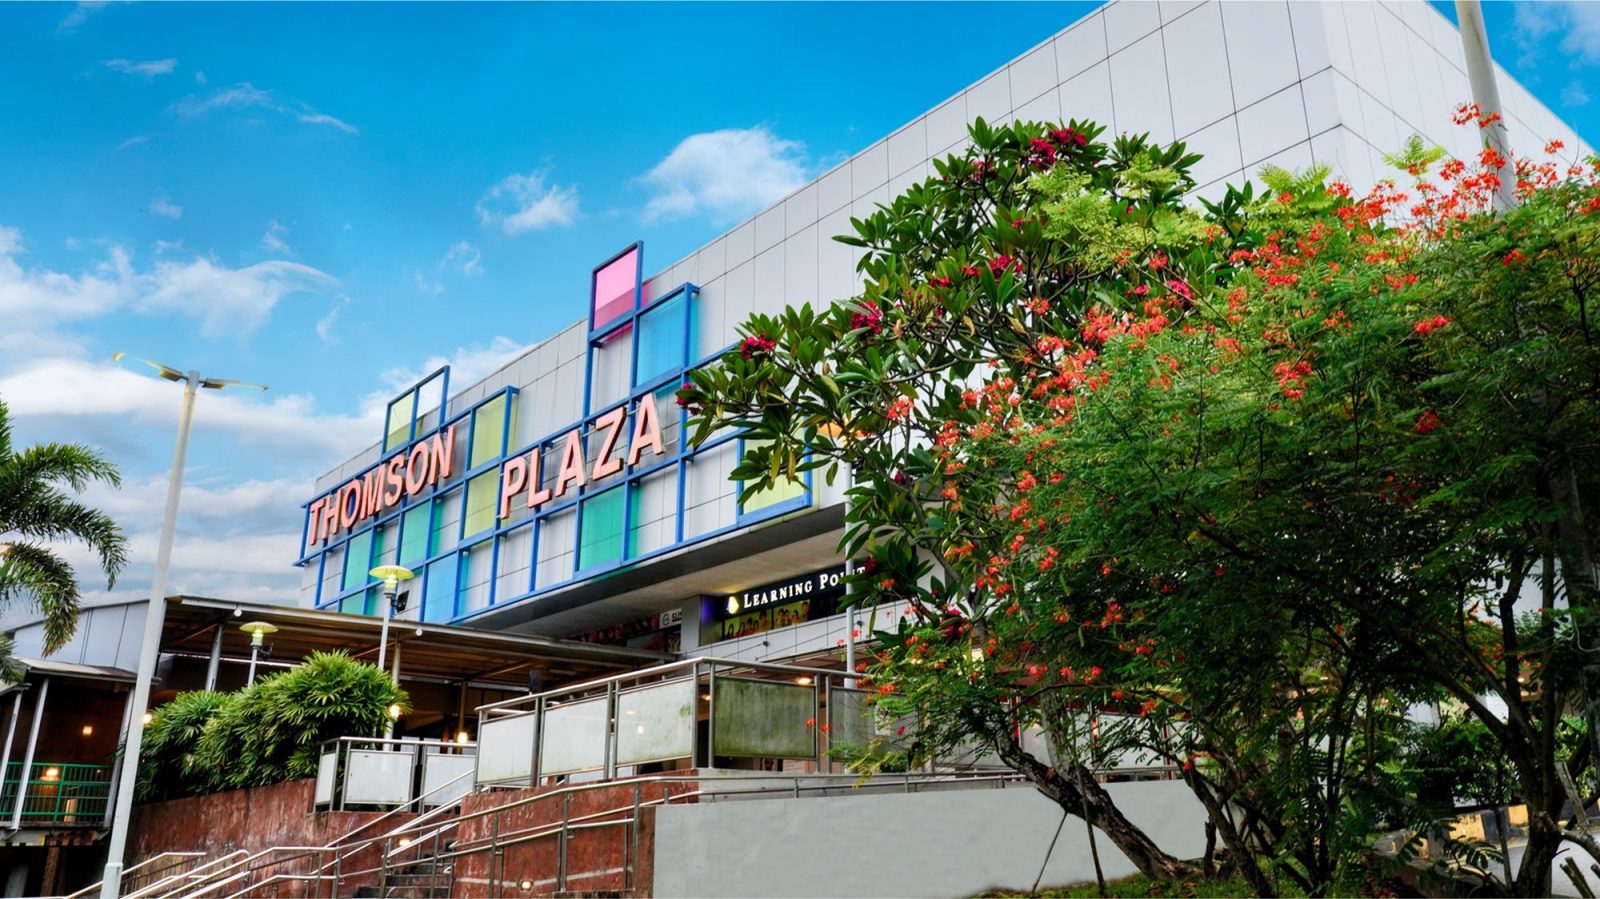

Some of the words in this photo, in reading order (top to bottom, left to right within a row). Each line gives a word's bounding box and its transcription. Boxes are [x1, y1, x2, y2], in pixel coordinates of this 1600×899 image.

[309, 426, 456, 546] THOMSON
[499, 394, 664, 520] PLAZA
[743, 581, 812, 608] LEARNING
